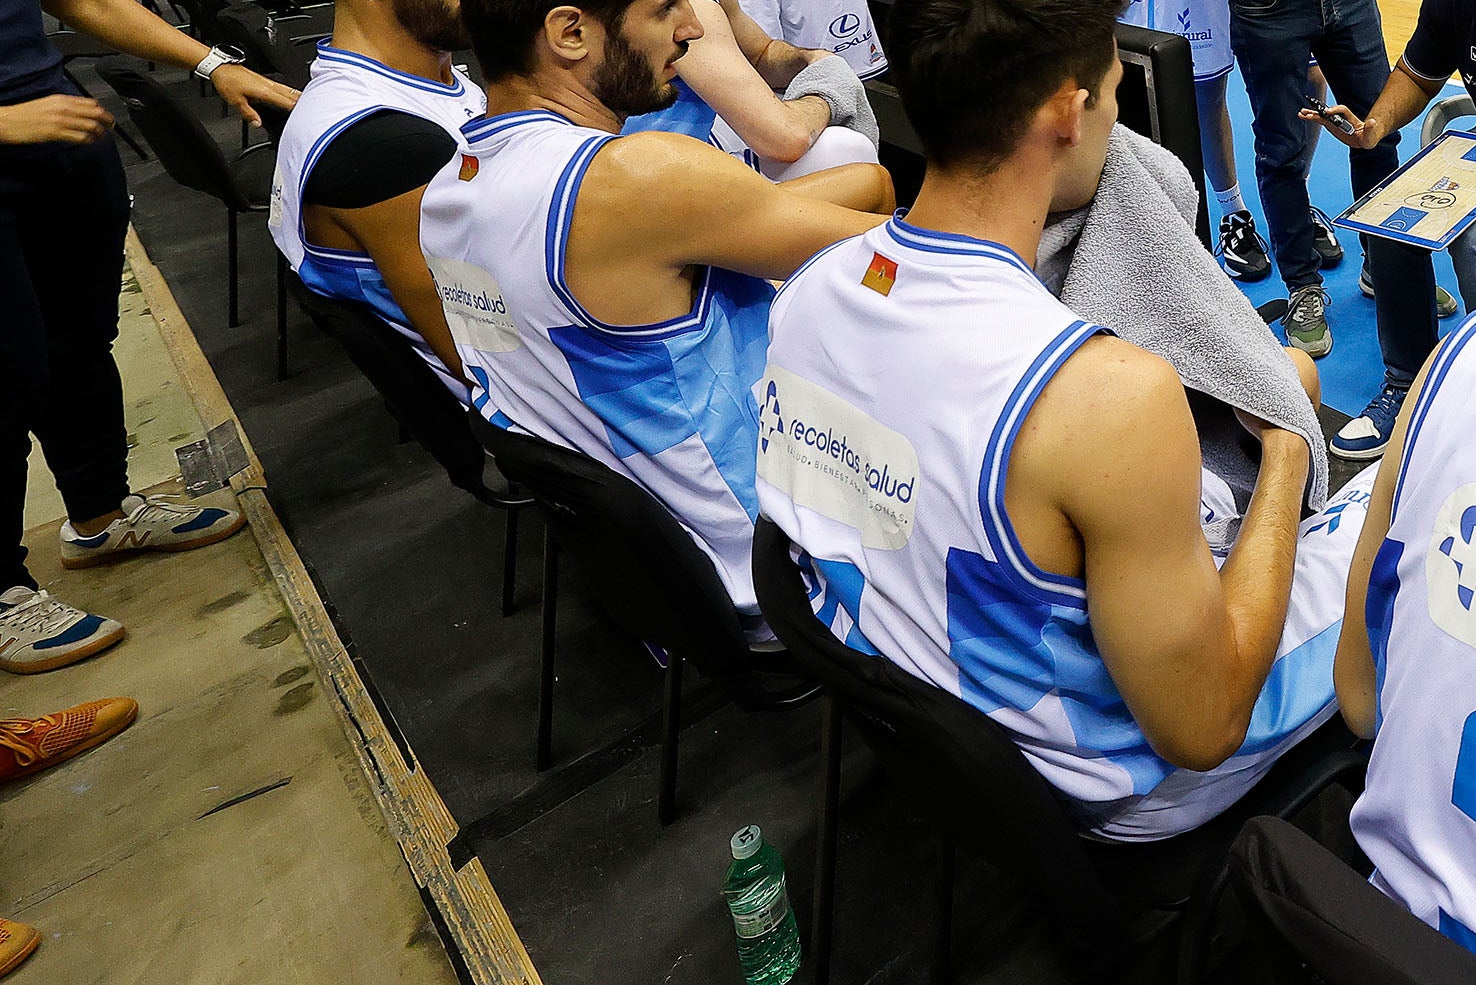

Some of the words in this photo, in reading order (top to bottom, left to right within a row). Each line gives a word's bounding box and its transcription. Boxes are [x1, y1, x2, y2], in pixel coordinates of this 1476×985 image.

[833, 29, 873, 53] EXUS
[442, 285, 472, 308] recoletas
[472, 289, 507, 314] salud
[789, 419, 860, 474] recoletas
[864, 464, 915, 504] salud
